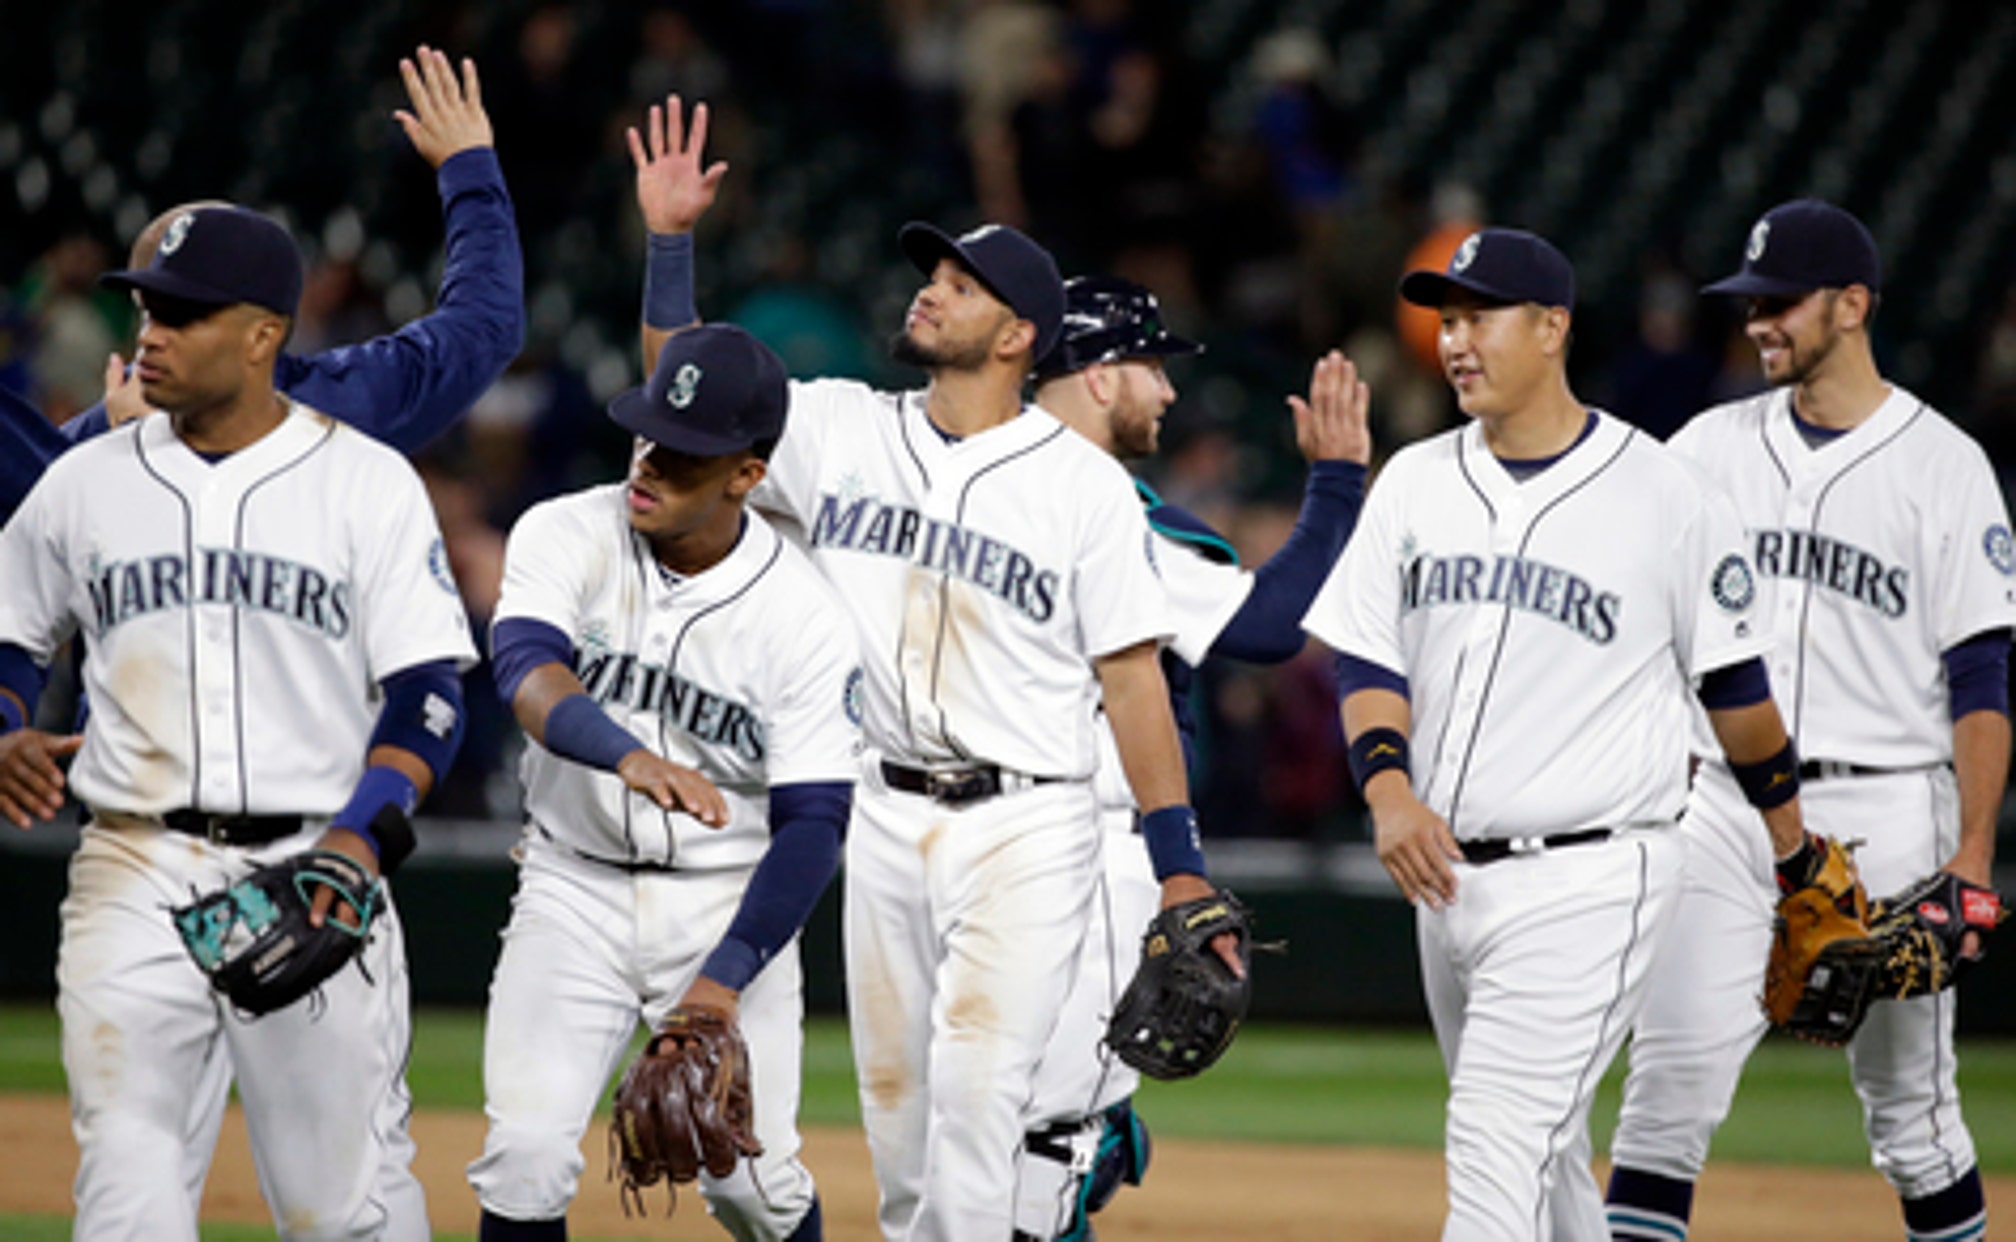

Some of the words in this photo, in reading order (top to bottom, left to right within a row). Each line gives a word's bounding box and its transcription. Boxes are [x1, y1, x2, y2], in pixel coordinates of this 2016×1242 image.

[159, 212, 196, 255] S
[1453, 233, 1482, 273] S
[1747, 220, 1770, 261] S
[667, 363, 703, 409] S
[811, 491, 1060, 624] MARINERS
[1744, 527, 1909, 620] RINERS
[573, 646, 765, 763] MINERS
